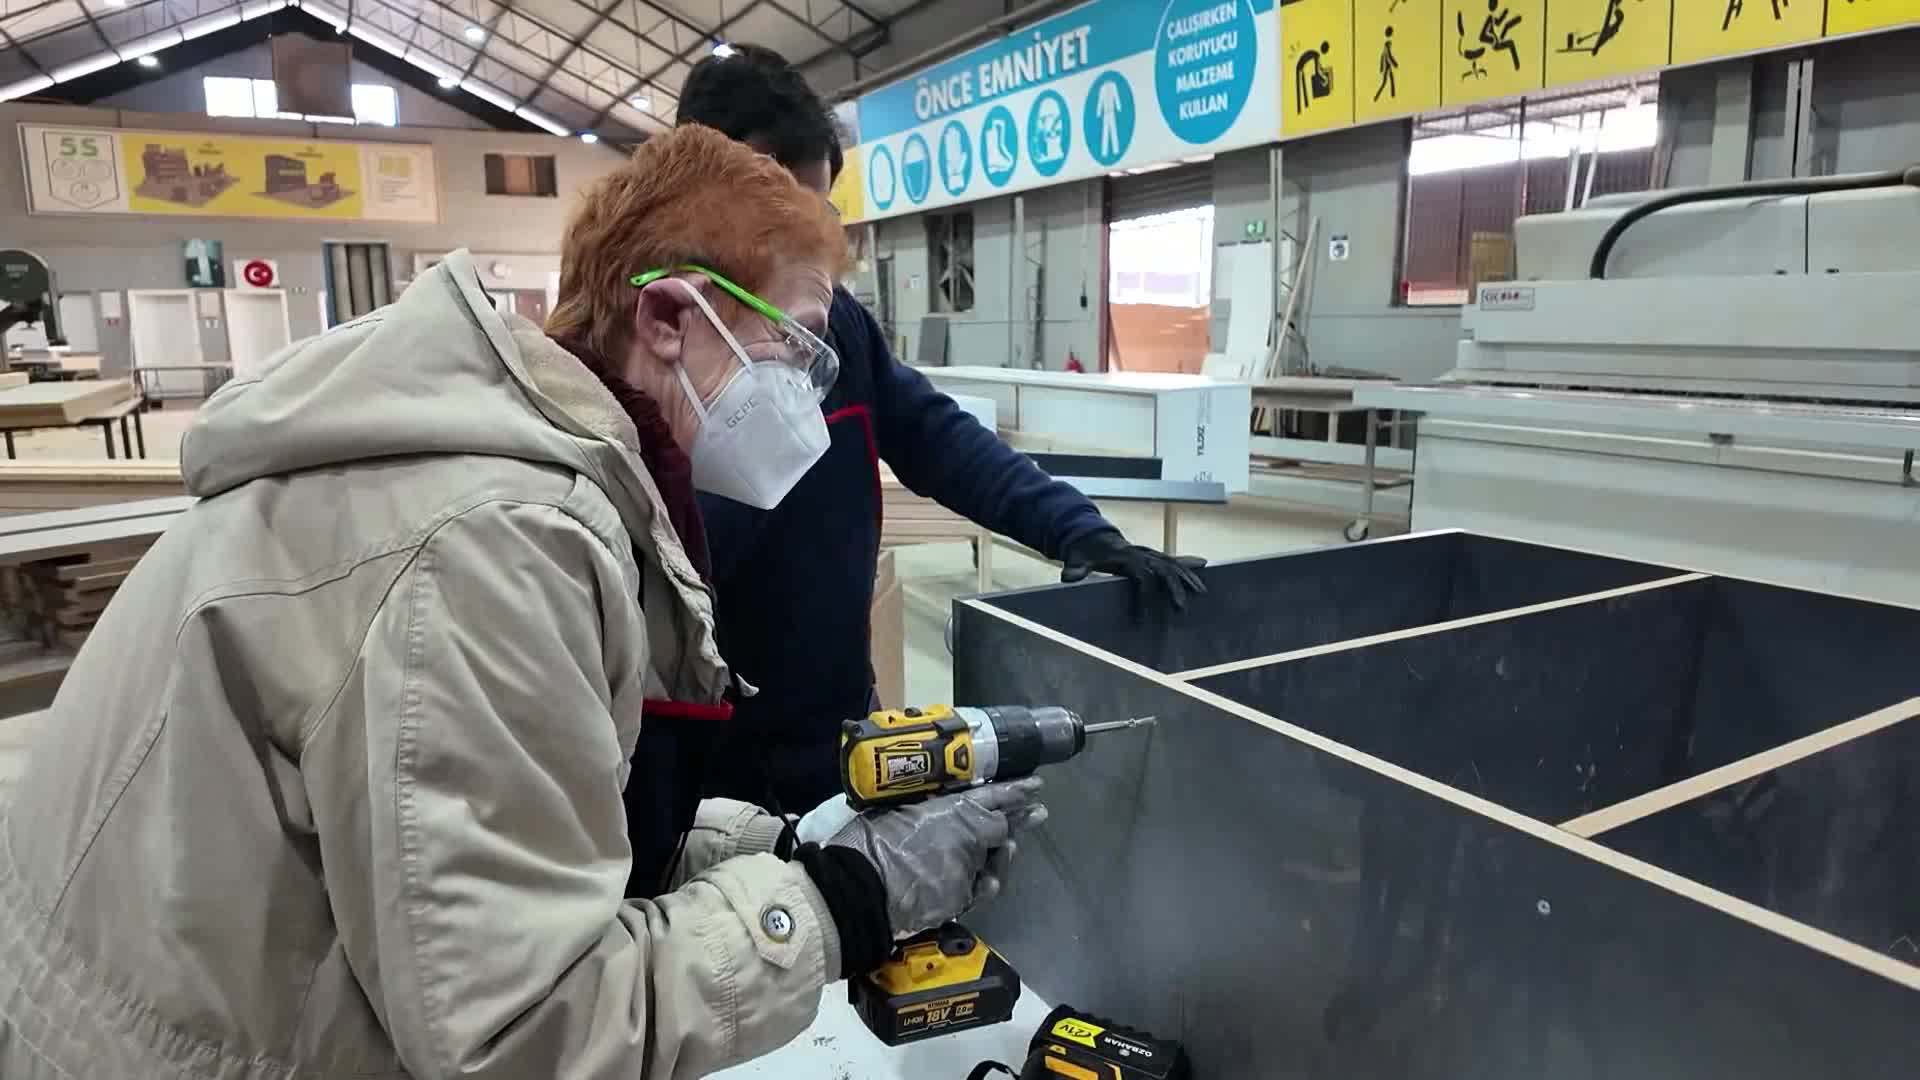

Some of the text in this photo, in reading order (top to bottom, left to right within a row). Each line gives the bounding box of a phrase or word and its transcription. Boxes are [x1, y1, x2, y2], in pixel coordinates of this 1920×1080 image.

[1168, 31, 1238, 67] KORUYUCU
[914, 26, 1091, 121] ÖNCE EMNİYET
[1176, 61, 1234, 93] MALZEME
[1179, 92, 1228, 120] KULLAN
[926, 1007, 951, 1023] 18V
